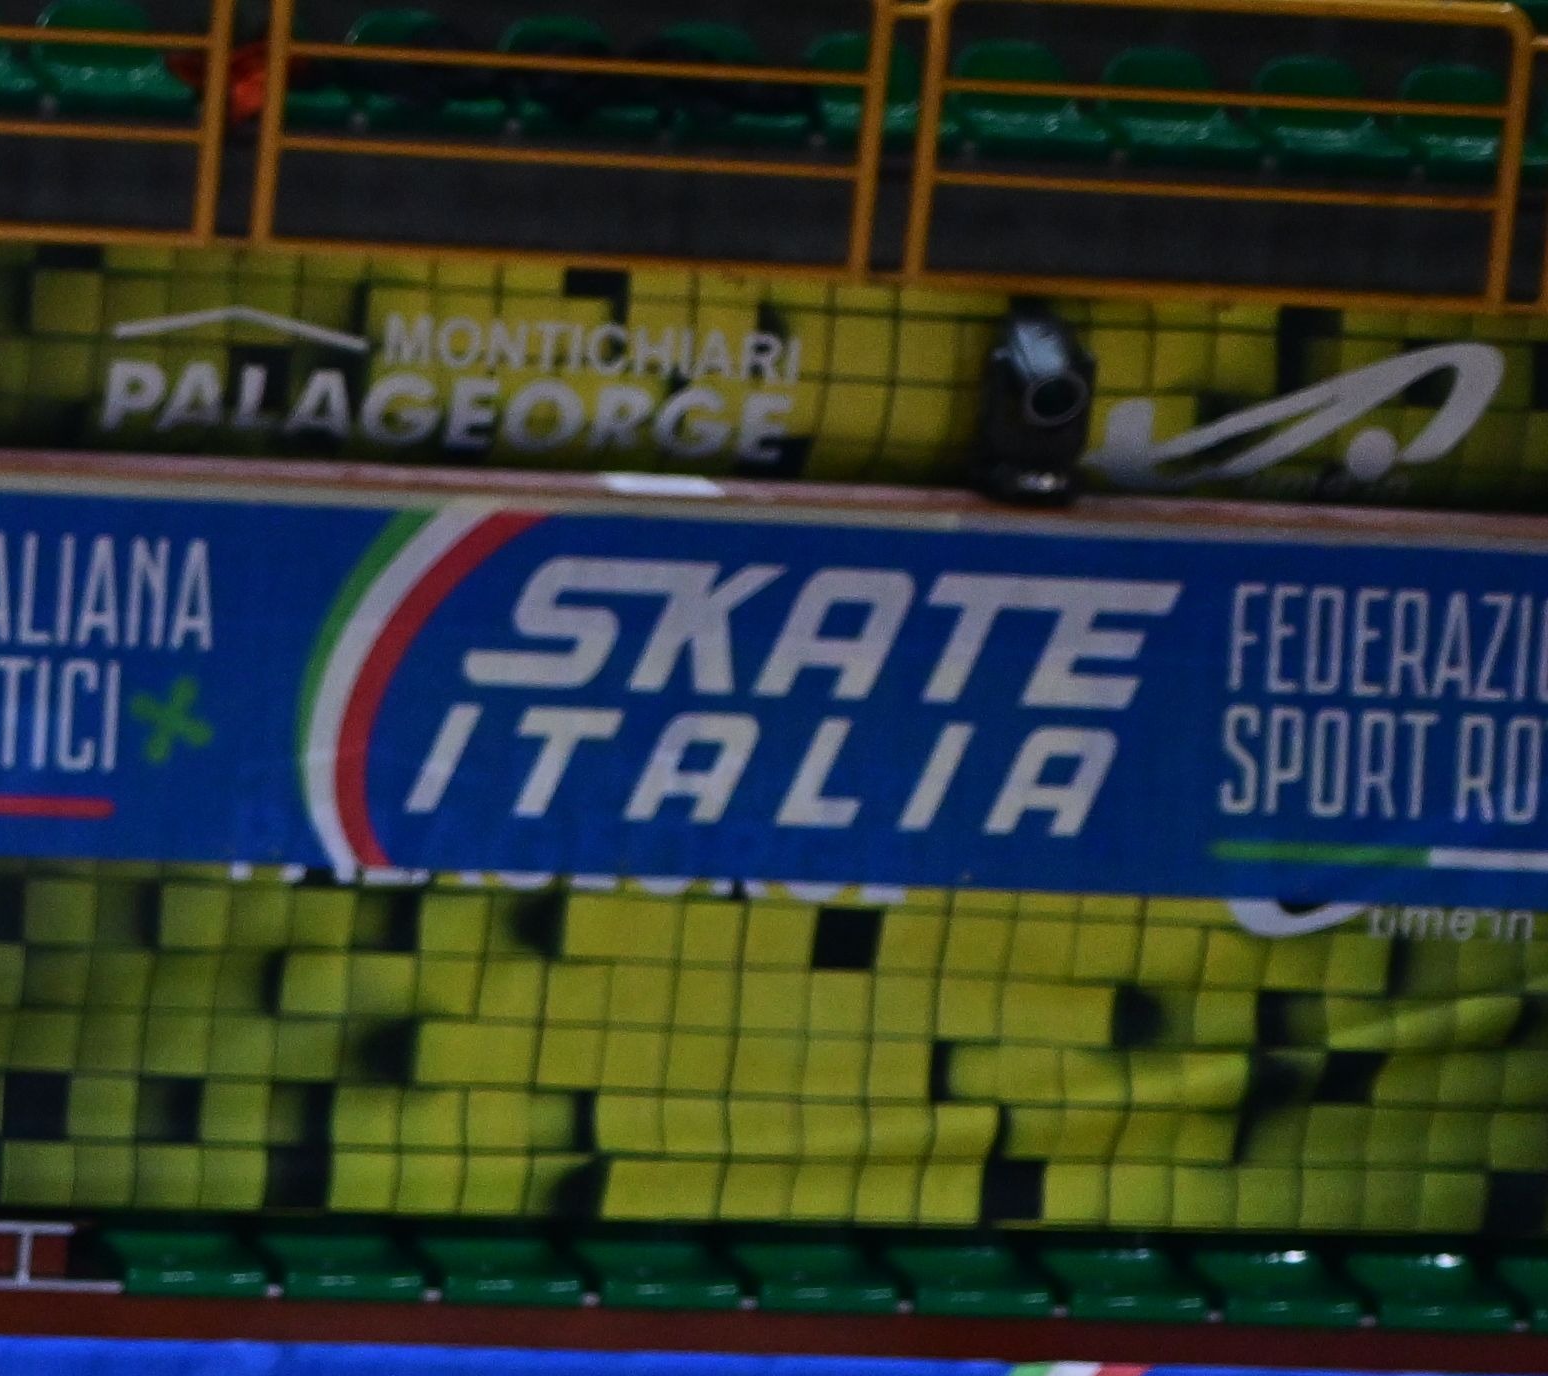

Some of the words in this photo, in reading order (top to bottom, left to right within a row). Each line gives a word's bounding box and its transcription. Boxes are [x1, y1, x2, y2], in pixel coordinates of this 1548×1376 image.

[384, 314, 802, 384] MONTICHIARI
[101, 360, 794, 462] PALAGEORGE
[463, 556, 1183, 710] SKATE
[1227, 582, 1548, 702] FEDERAZI
[404, 703, 1118, 838] ITALIA
[1219, 705, 1440, 820] SPORT
[1454, 713, 1548, 824] RO
